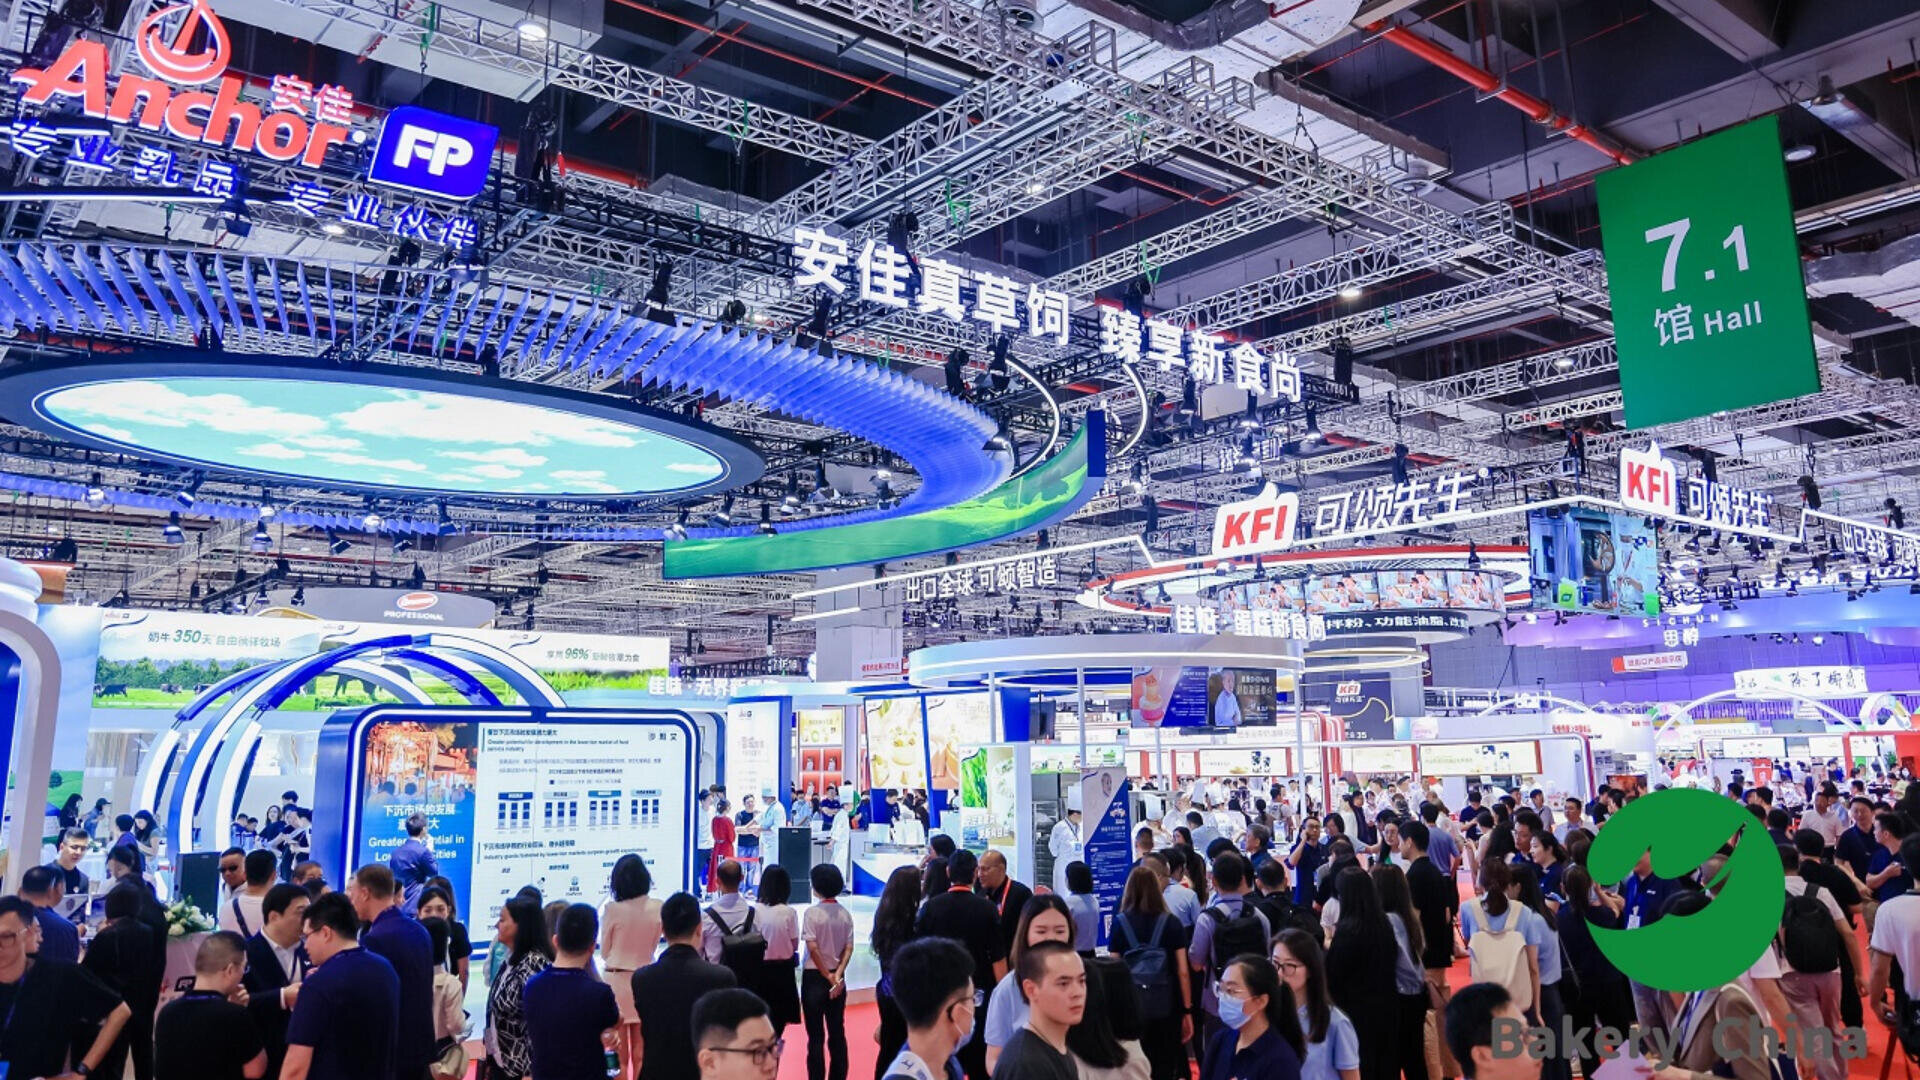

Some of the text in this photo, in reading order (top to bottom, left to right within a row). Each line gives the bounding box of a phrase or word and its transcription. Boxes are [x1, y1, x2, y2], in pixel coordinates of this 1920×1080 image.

[10, 39, 348, 168] Anchor
[270, 73, 354, 126] 安佳
[393, 123, 475, 177] FP
[1644, 217, 1750, 292] 7.1
[792, 227, 1302, 404] 安佳真草饲 臻享新食尚
[1653, 300, 1762, 347] 馆 Hall
[1314, 470, 1476, 535] 可颂先生
[1626, 461, 1670, 507] KFI
[1687, 476, 1768, 530] 可颂先生
[1222, 504, 1289, 549] KFI
[906, 567, 976, 602] 出口全球
[383, 609, 444, 621] PROFESSIONAL
